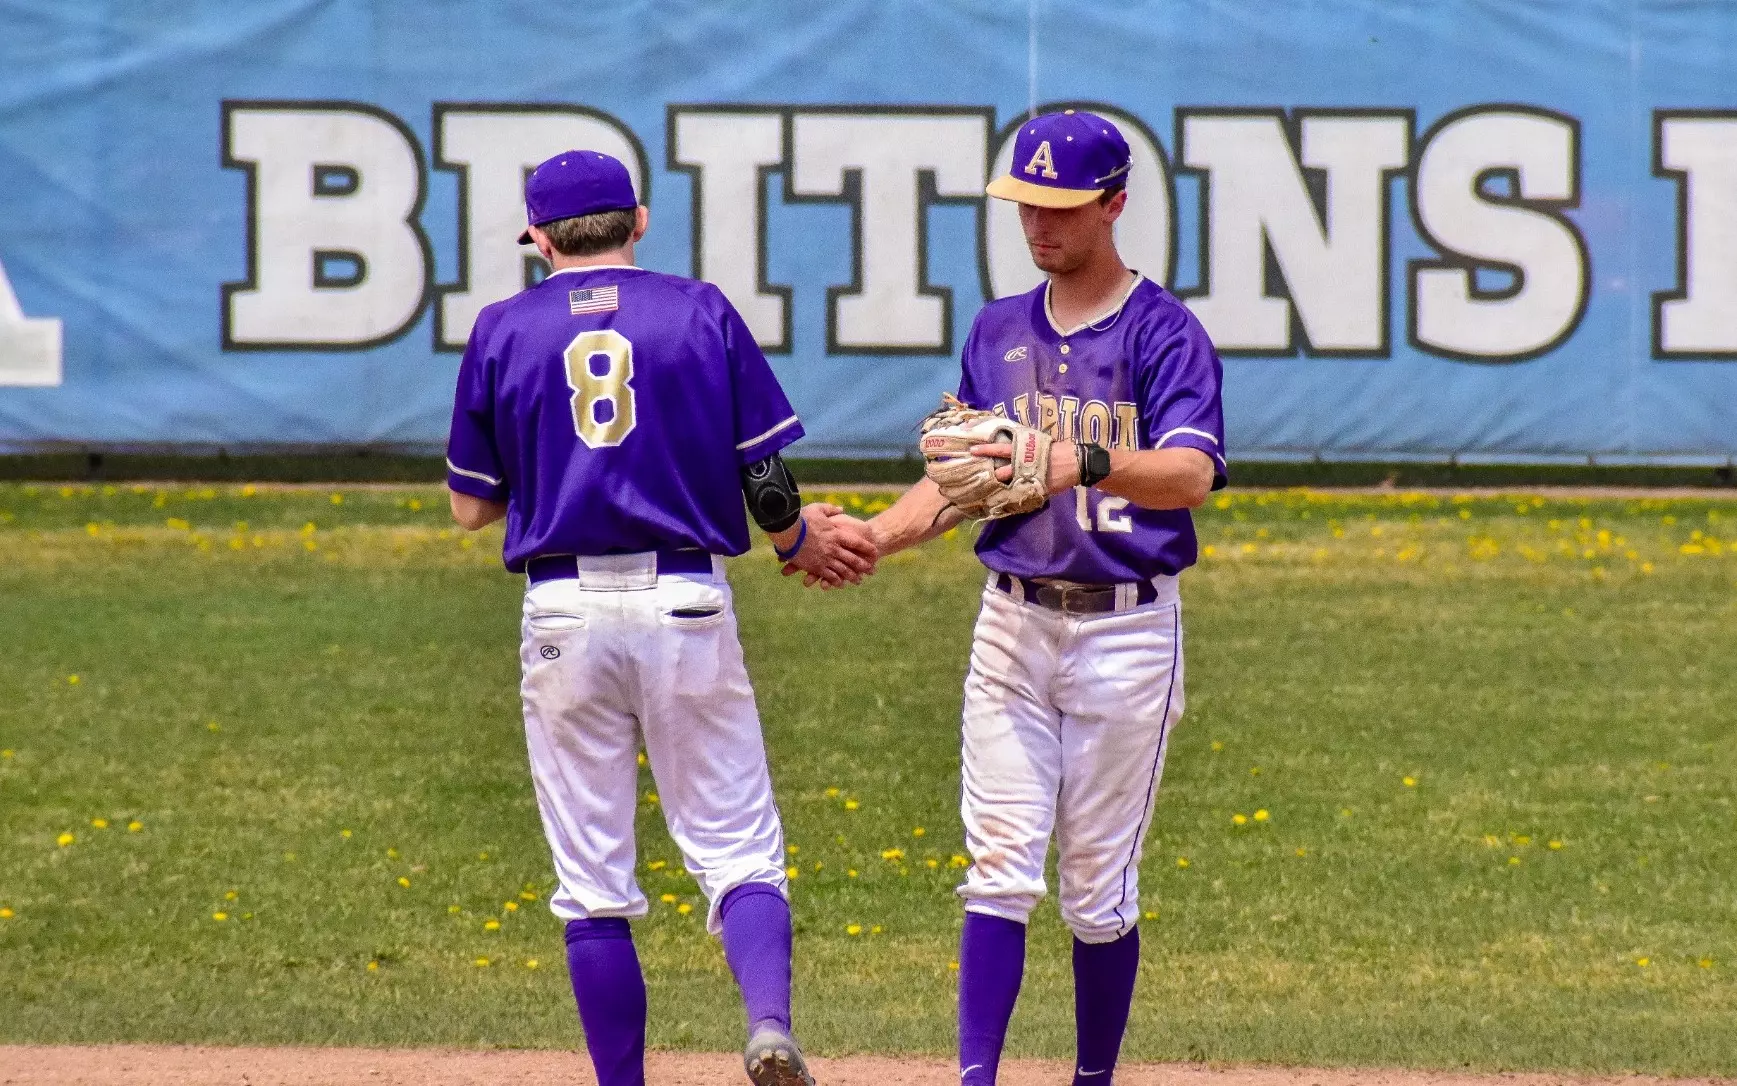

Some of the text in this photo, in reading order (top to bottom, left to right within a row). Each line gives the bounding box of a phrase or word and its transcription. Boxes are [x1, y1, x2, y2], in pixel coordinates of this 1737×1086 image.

[1024, 140, 1058, 179] A
[563, 329, 637, 449] 8
[1073, 484, 1133, 533] 12
